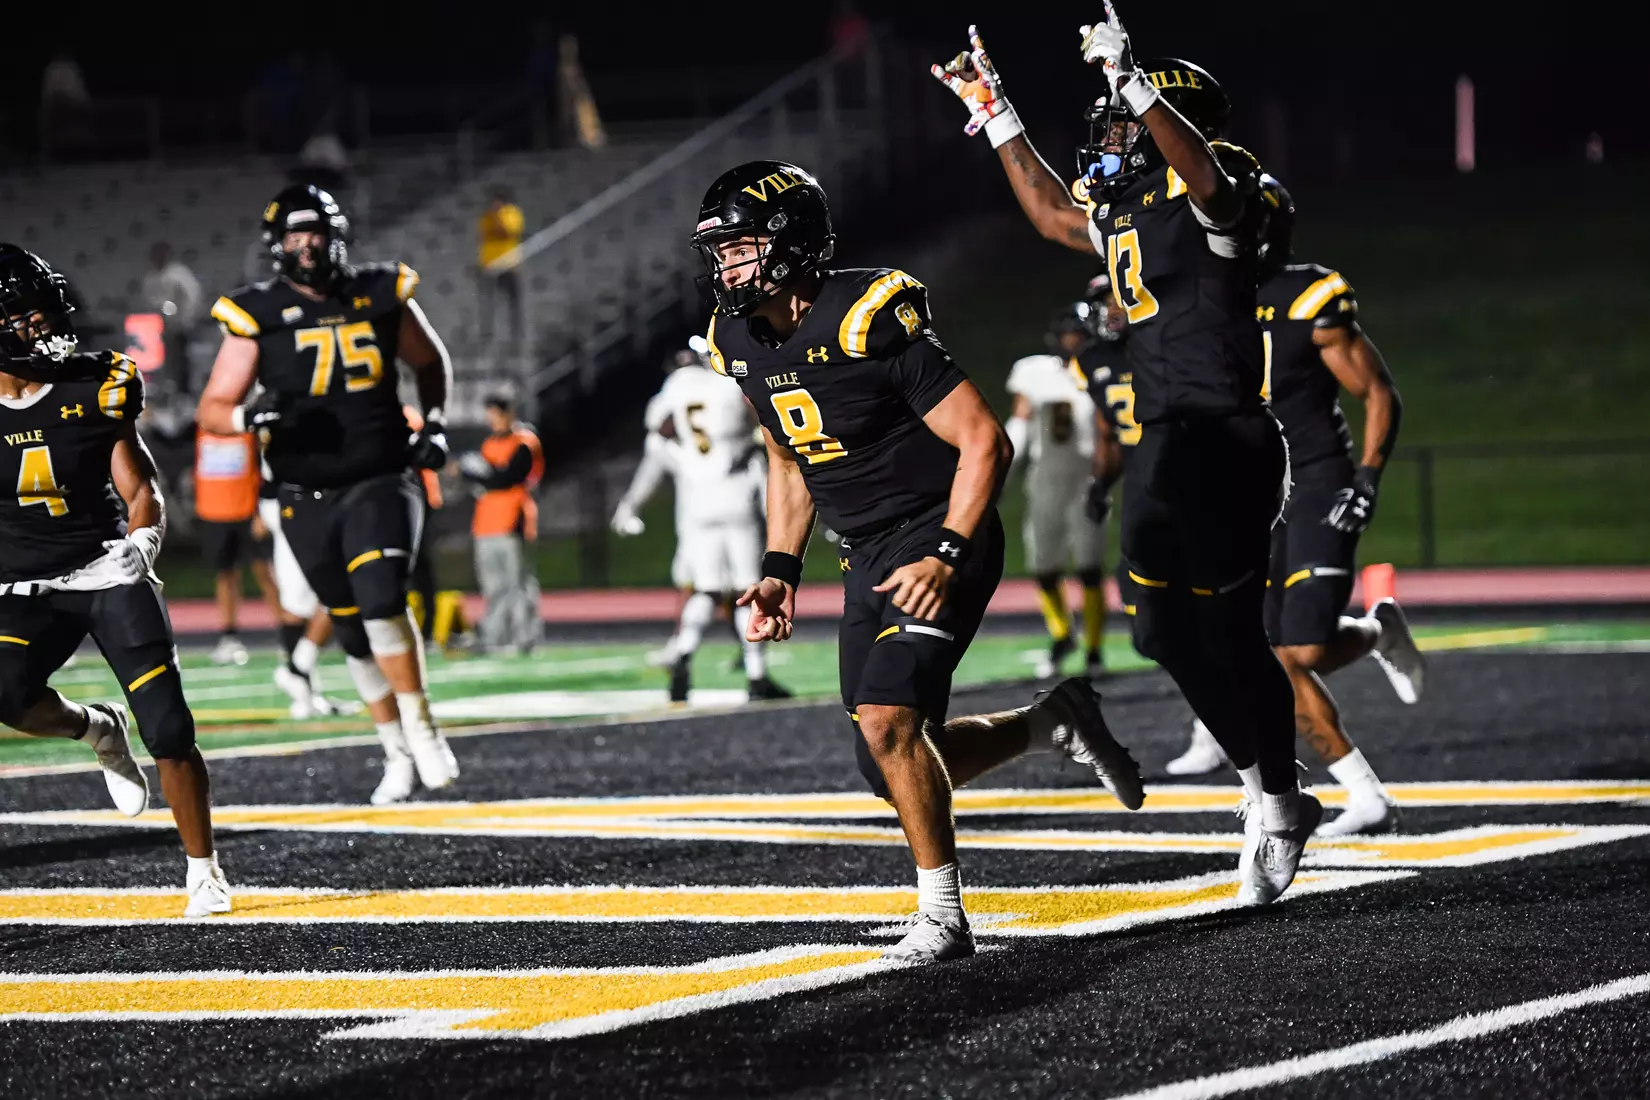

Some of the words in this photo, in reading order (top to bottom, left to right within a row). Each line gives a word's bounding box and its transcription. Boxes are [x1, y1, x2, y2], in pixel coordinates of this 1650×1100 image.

[1145, 69, 1203, 90] ILLE
[1107, 227, 1160, 325] 13
[894, 301, 922, 338] 8
[294, 320, 384, 397] 75
[764, 371, 801, 390] VILLE
[3, 429, 45, 447] VILLE
[769, 387, 849, 465] 8
[1104, 382, 1143, 446] 3
[16, 445, 70, 517] 4
